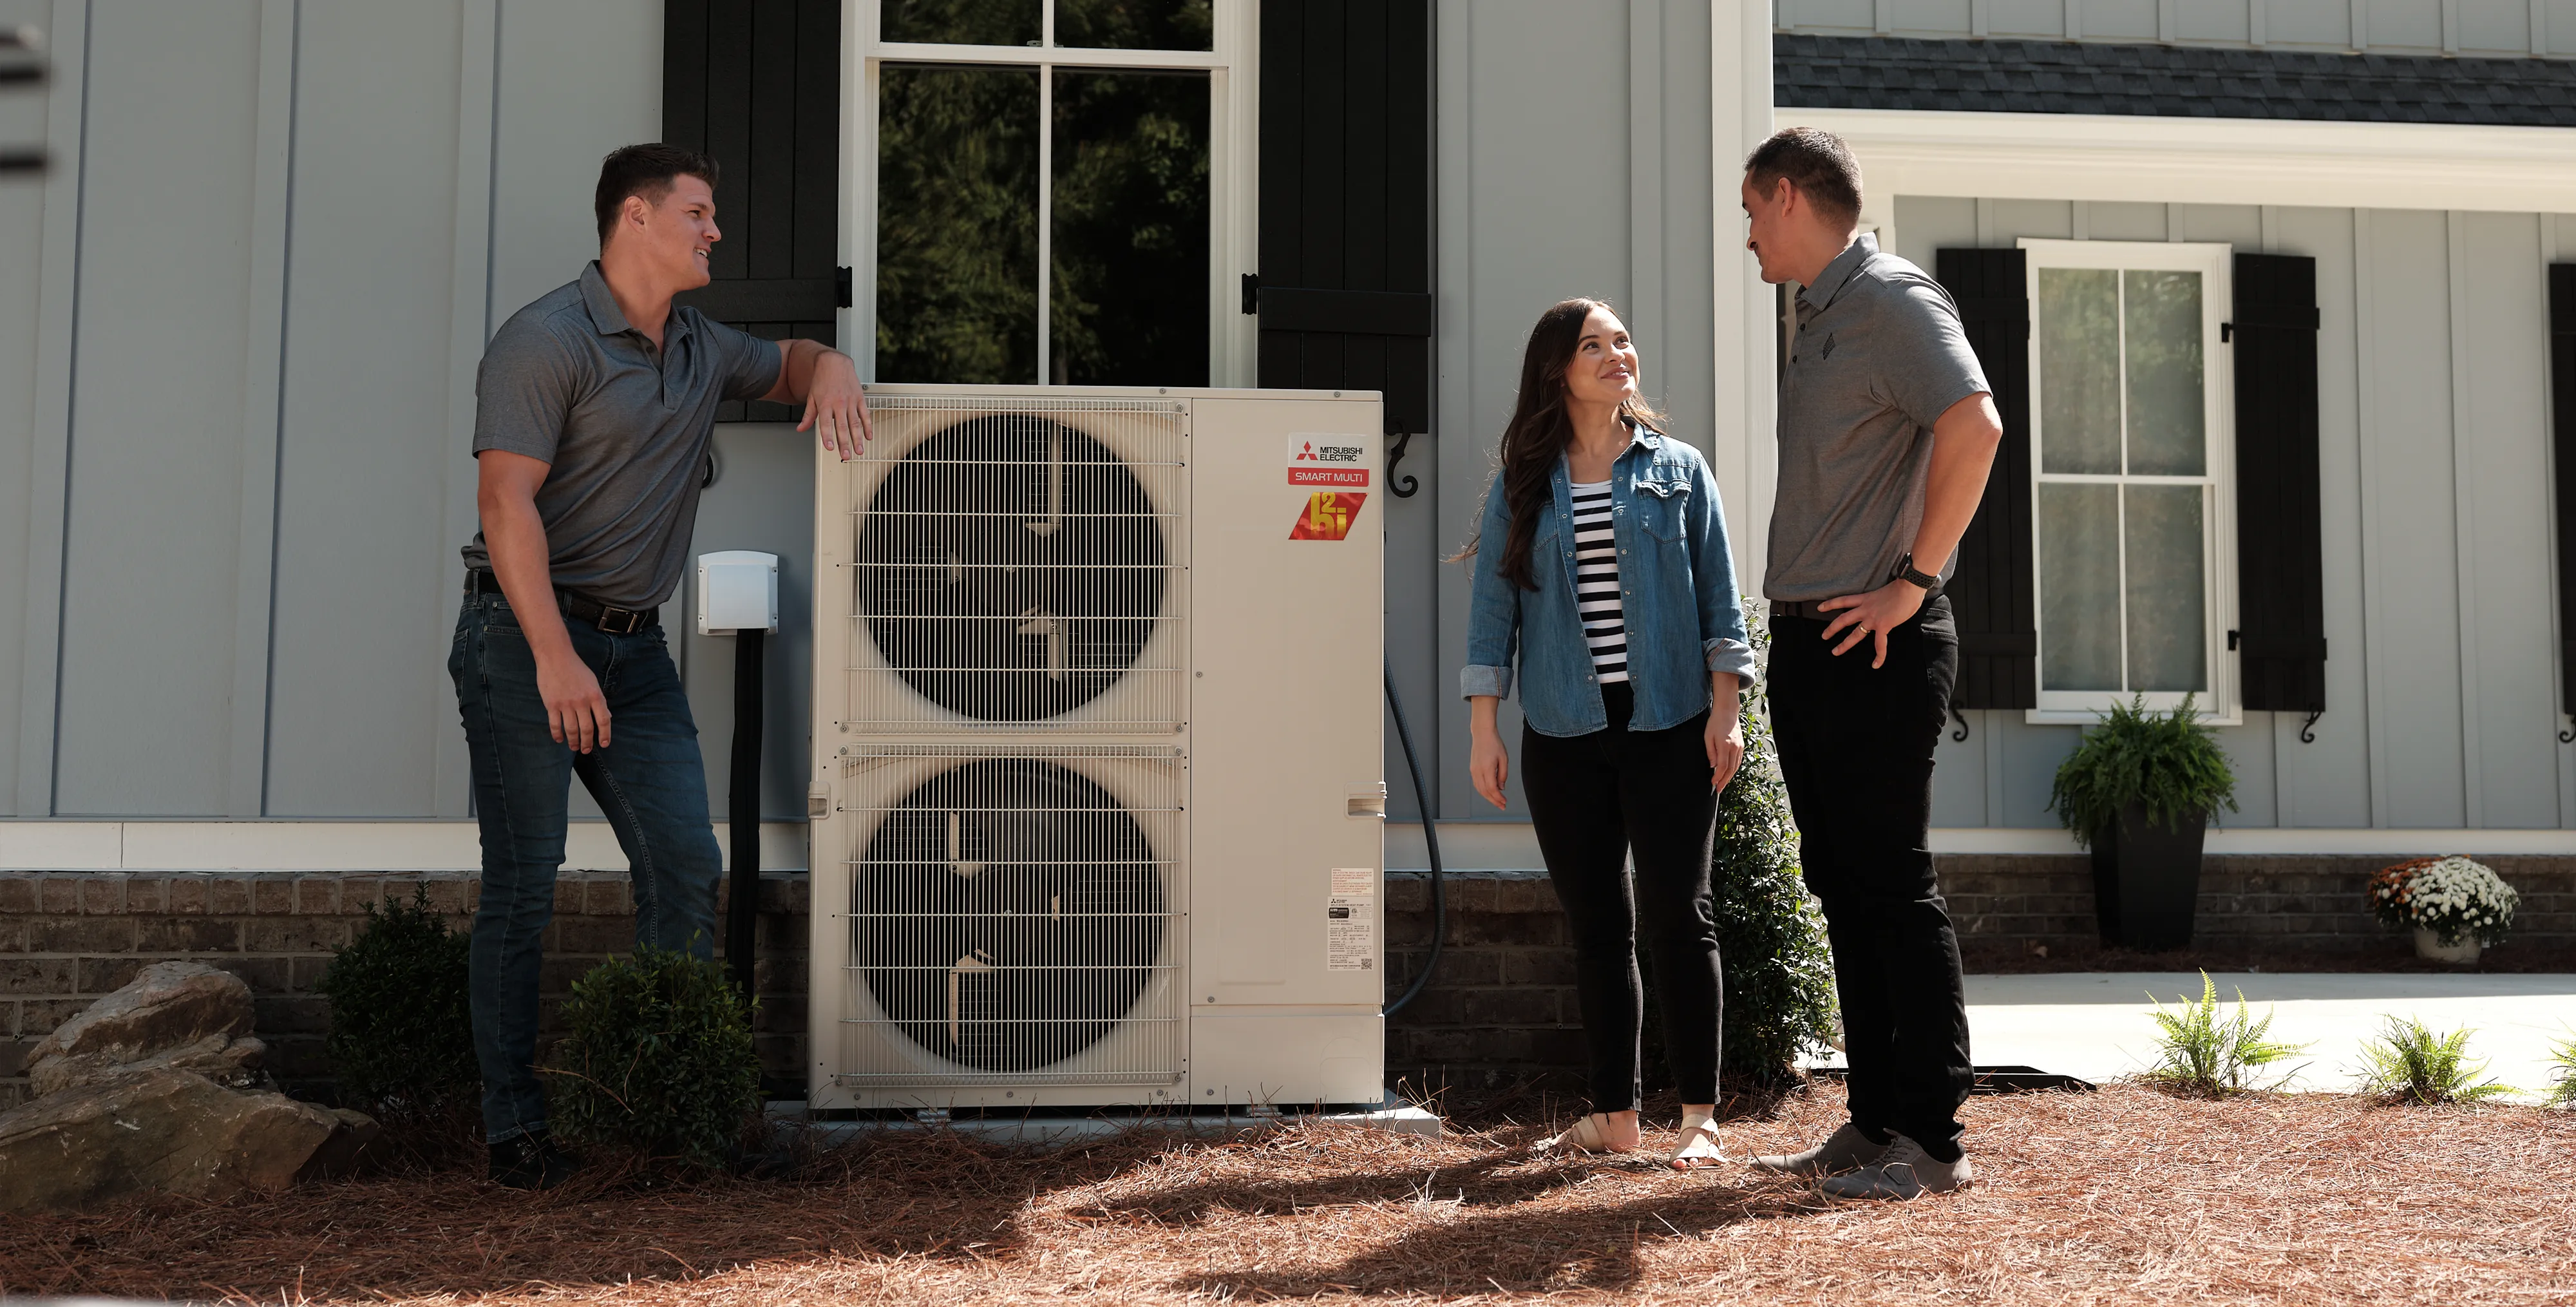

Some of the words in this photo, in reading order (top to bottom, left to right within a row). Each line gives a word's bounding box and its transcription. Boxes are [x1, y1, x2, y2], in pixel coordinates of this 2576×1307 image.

[1320, 446, 1363, 455] MITSUBISHI
[1295, 472, 1332, 481] SMART
[1334, 473, 1363, 482] MULTI
